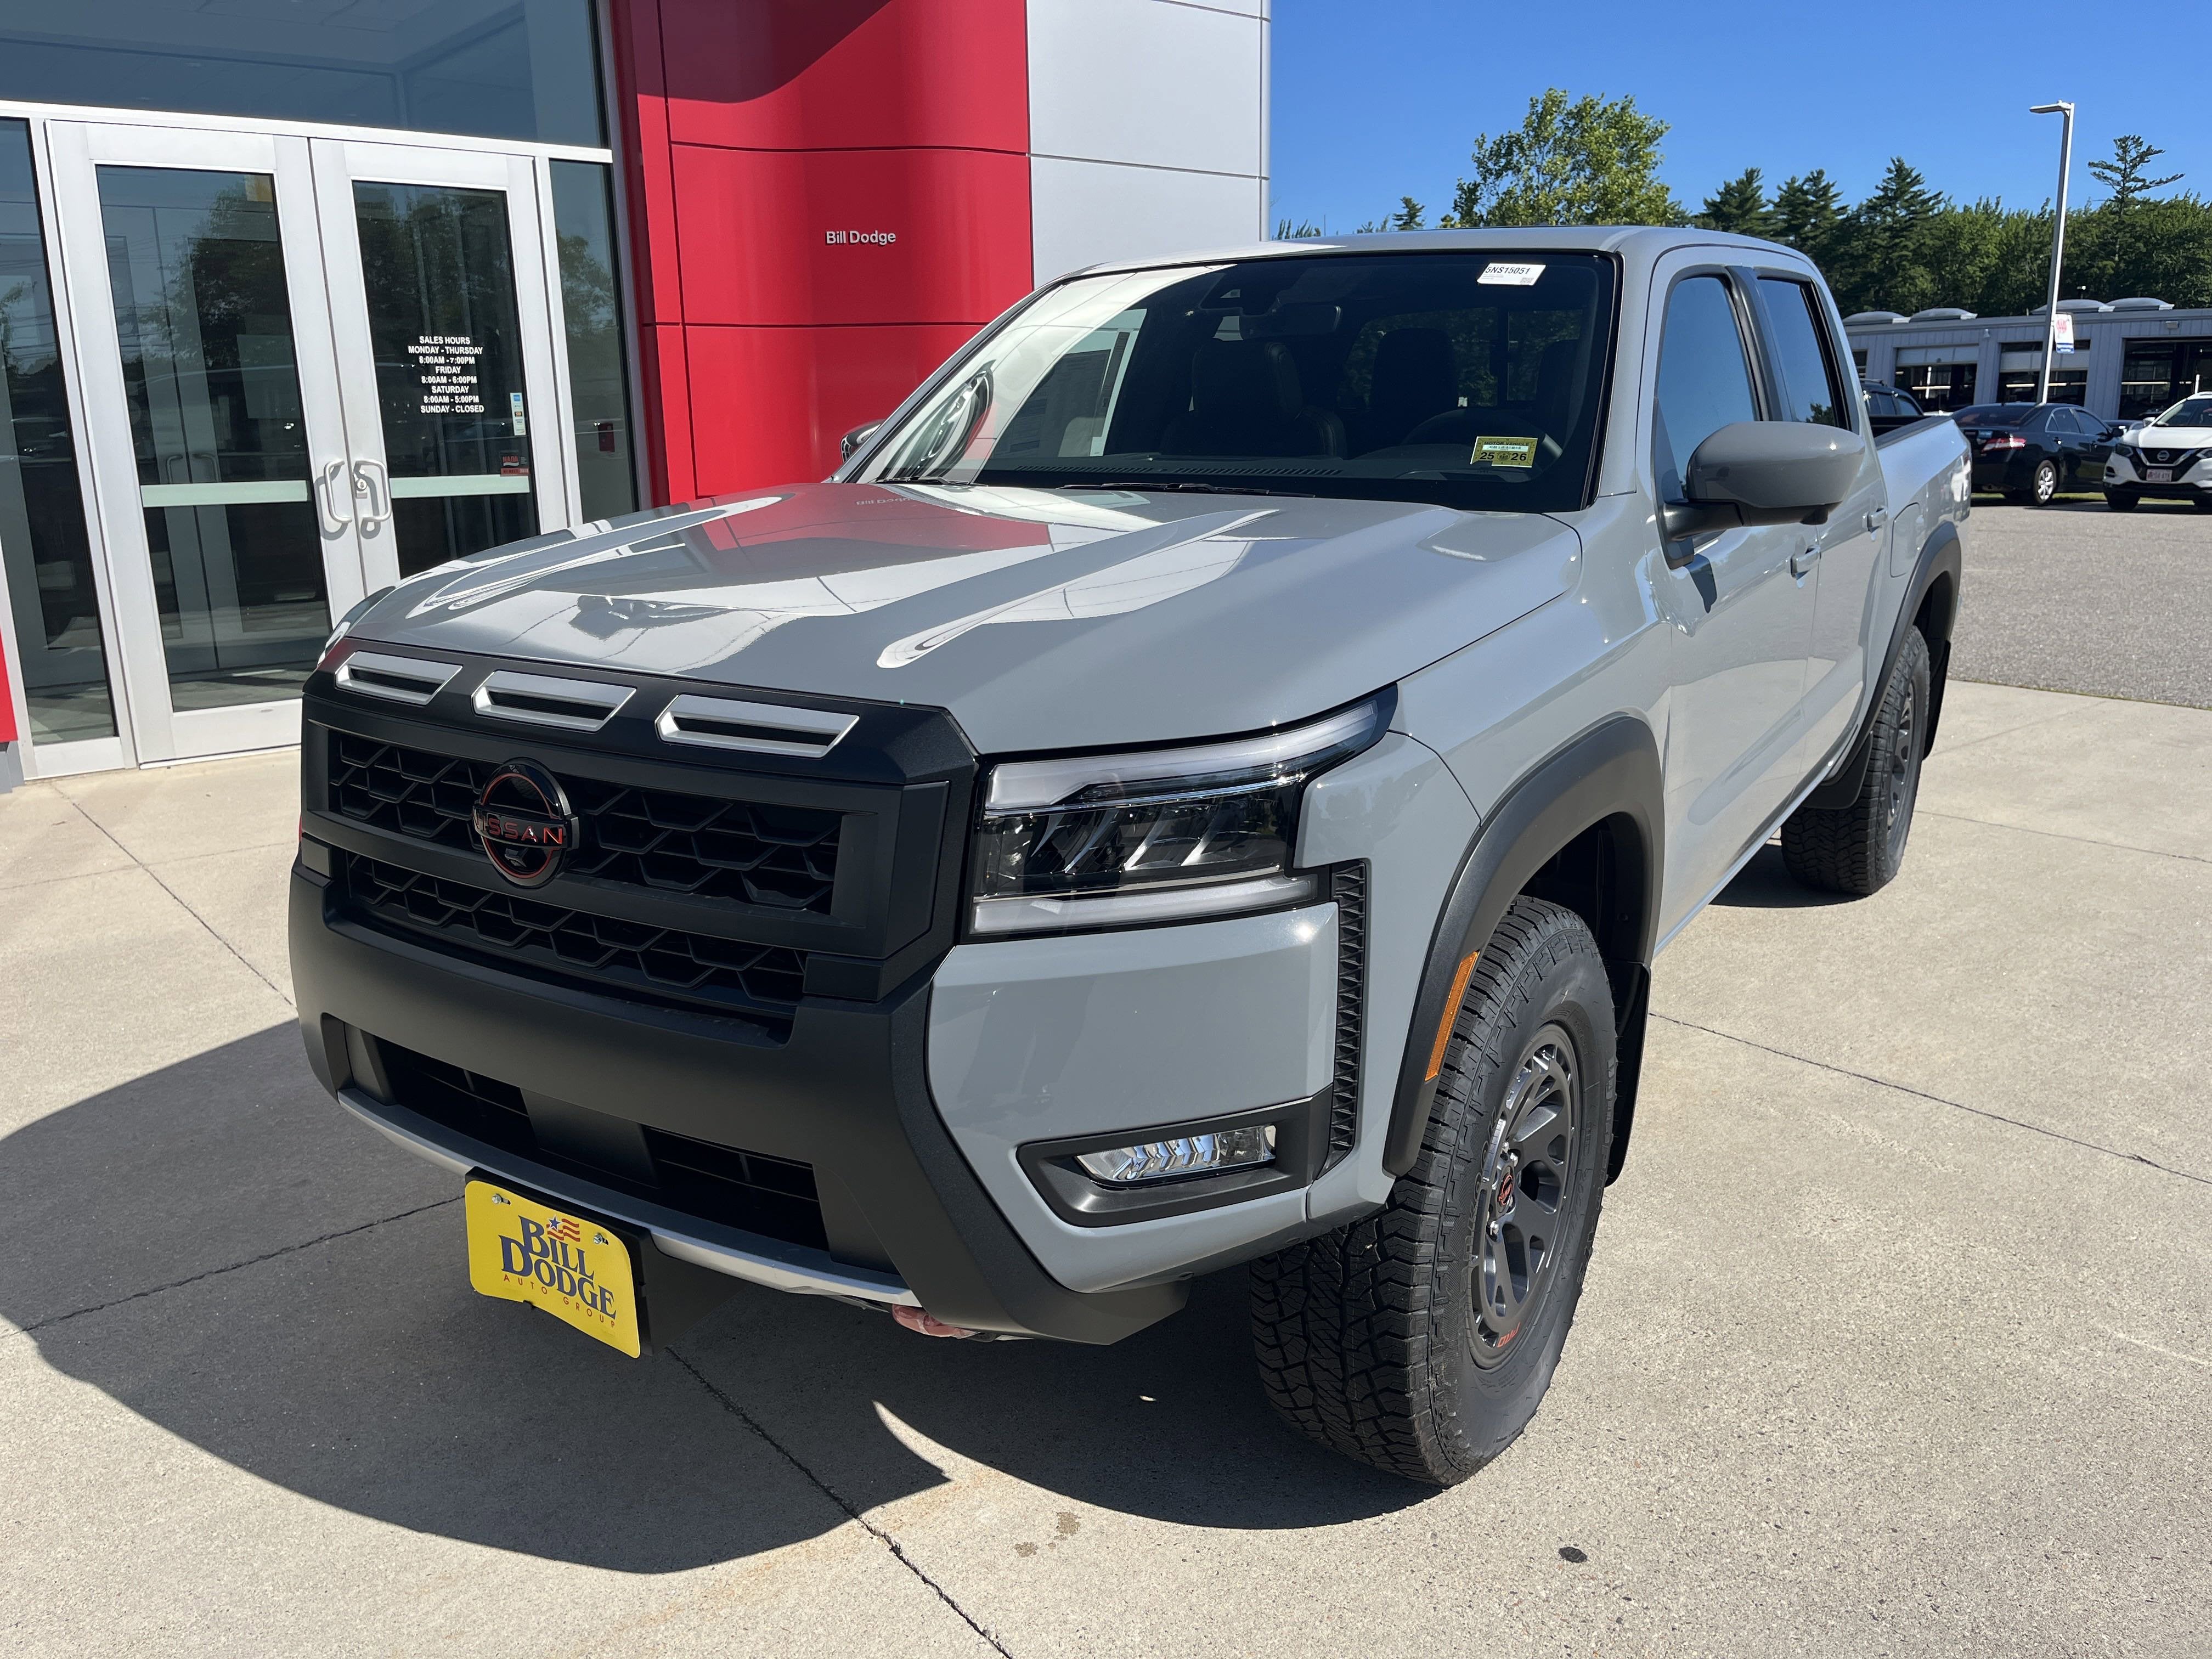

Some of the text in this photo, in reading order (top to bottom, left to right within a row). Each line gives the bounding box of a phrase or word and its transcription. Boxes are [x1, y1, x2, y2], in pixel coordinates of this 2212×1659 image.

[826, 230, 896, 245] Bill Dodge
[1485, 266, 1531, 275] 5NS15051
[419, 336, 471, 345] SALES HOURS
[408, 346, 439, 354] MONDAY
[444, 346, 483, 354] THURSDAY
[419, 356, 445, 364] 8:00AM
[449, 356, 475, 364] 7:00PM
[421, 375, 447, 383] 8:00AM
[424, 395, 449, 403] 8:00AM
[454, 395, 479, 403] 5:00PM
[420, 405, 450, 413] SUNDAY
[455, 405, 484, 413] CLOSED
[1479, 452, 1527, 461] 25 26
[517, 1215, 595, 1281] BILL
[498, 1234, 617, 1321] DODGE
[504, 1274, 616, 1328] AUTO GROUP
